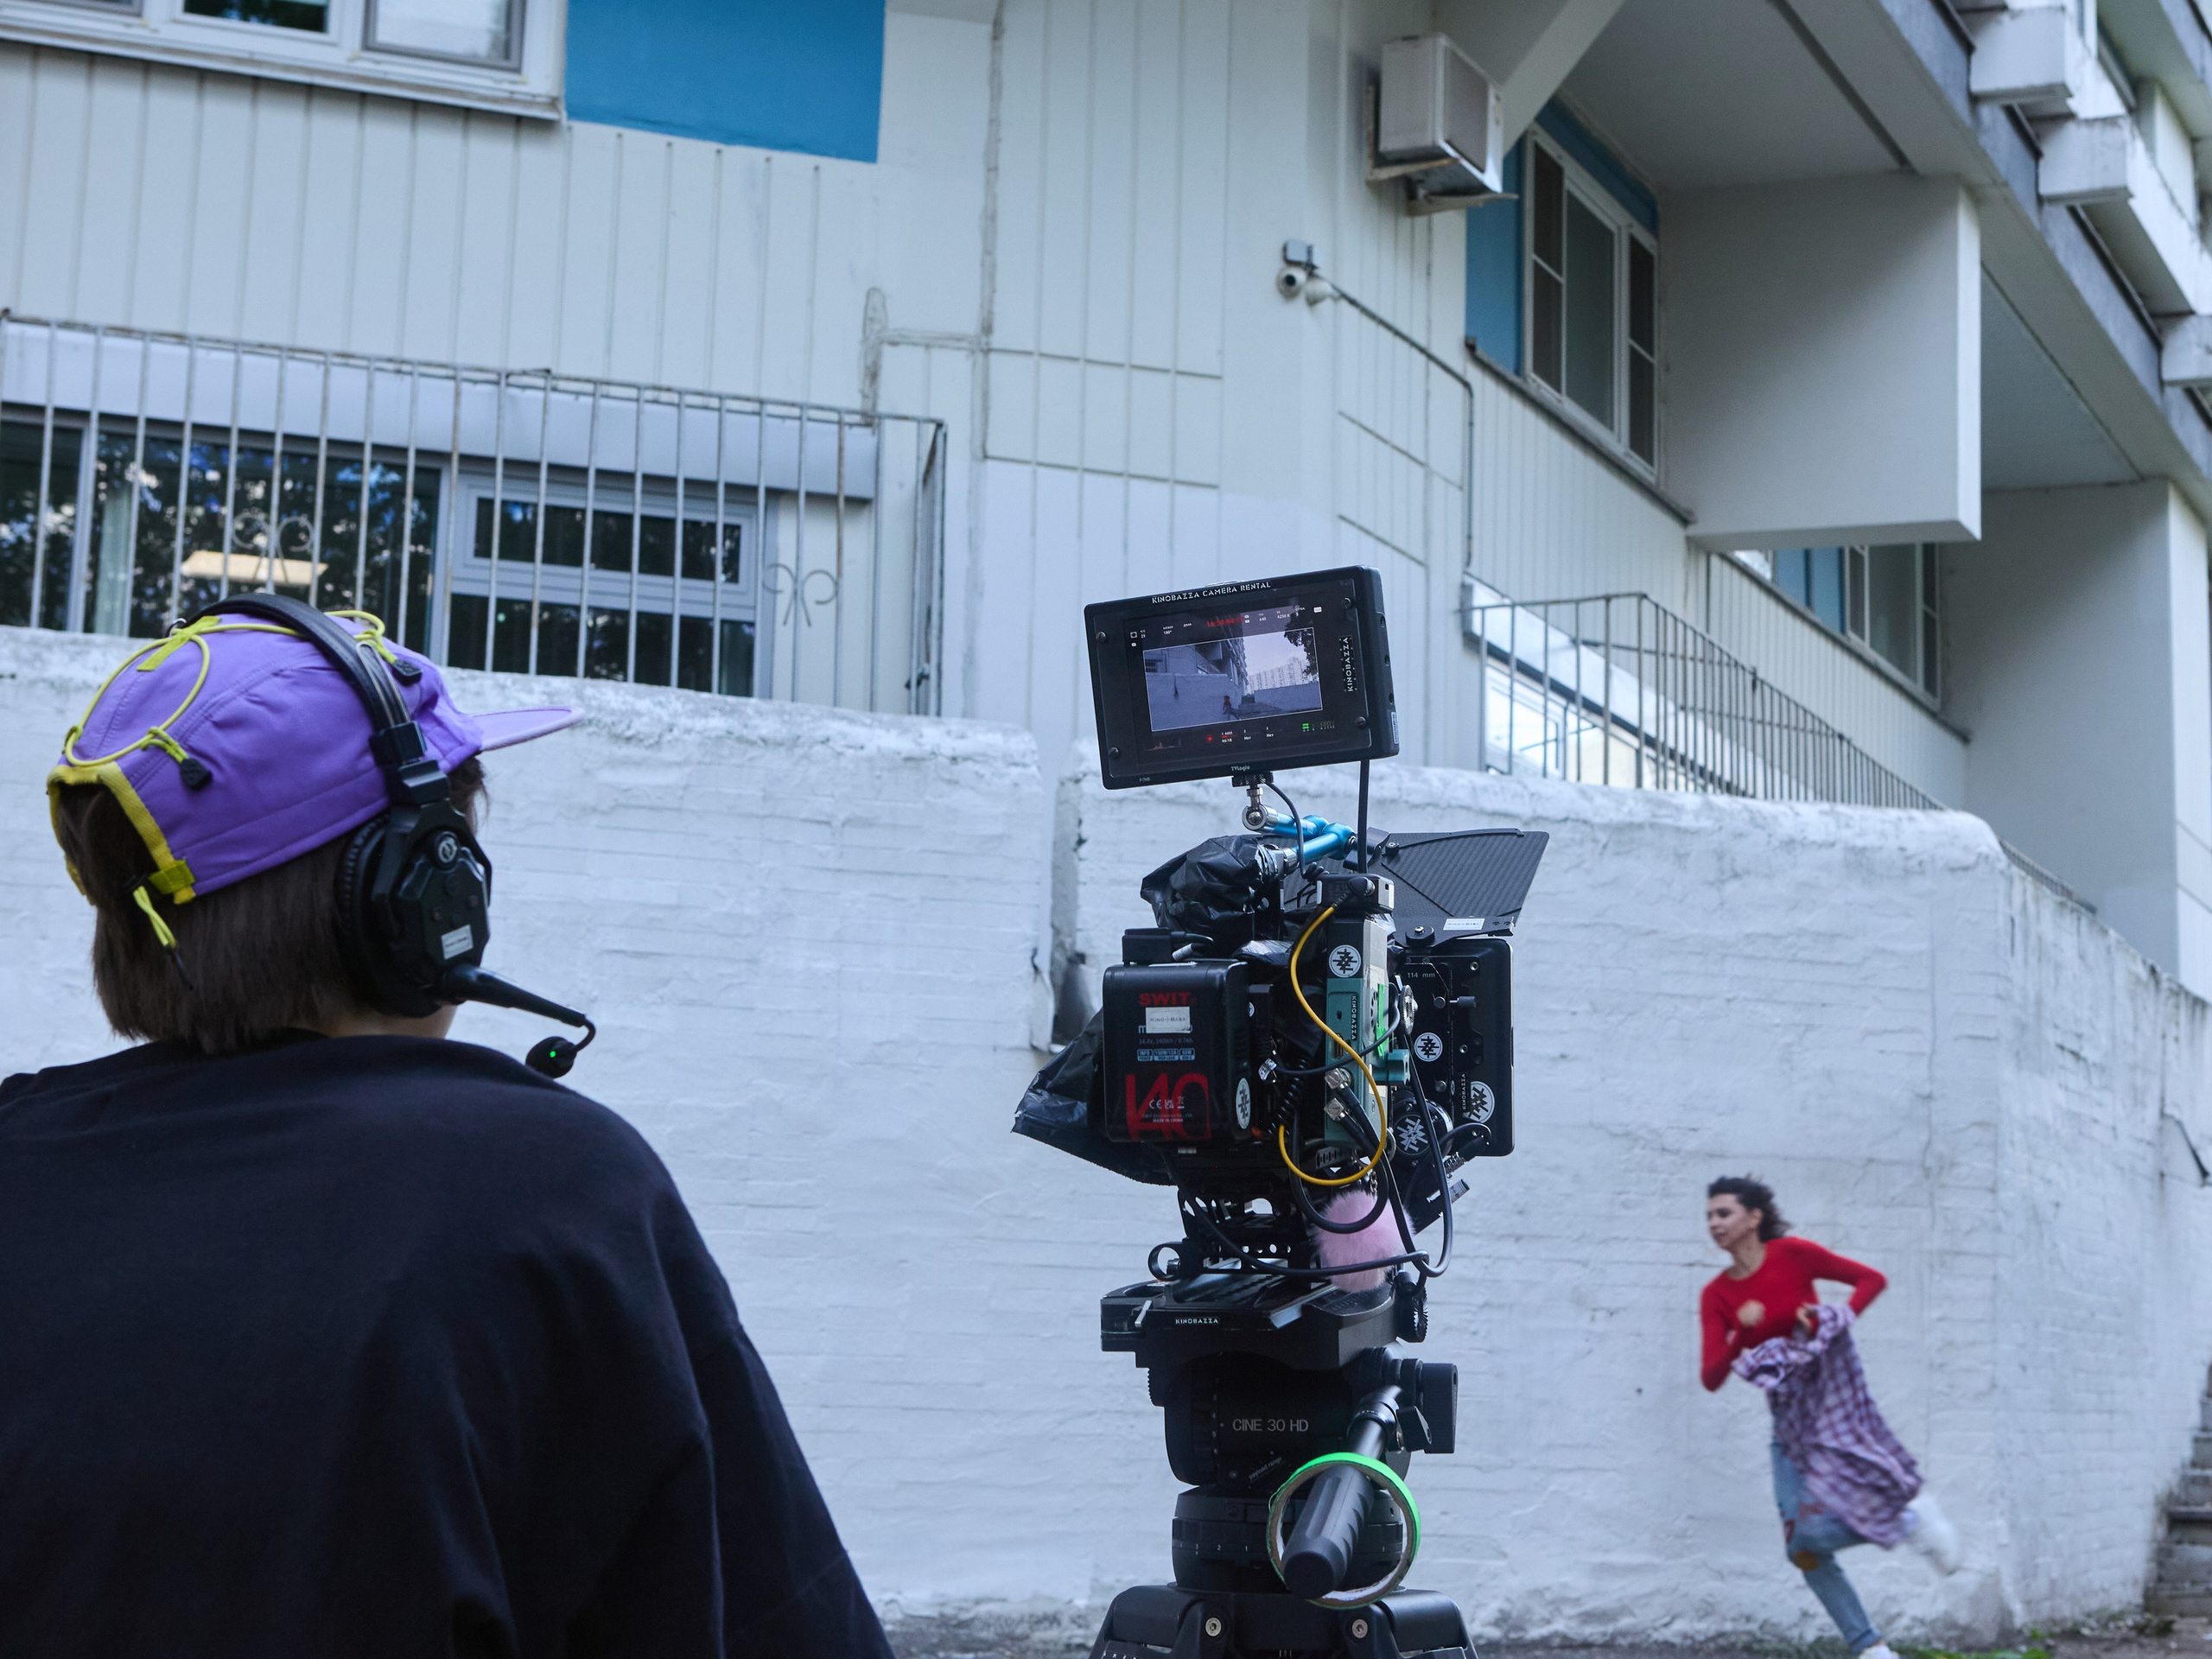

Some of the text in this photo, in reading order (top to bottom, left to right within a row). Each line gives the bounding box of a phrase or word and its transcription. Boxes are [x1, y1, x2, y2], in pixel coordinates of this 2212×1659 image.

[1152, 582, 1271, 604] KINOBAZZA CAMERA RENTAL
[1342, 637, 1354, 692] KINOBAZZA
[1139, 992, 1191, 1007] SWIT
[1232, 1419, 1309, 1432] CINE 30 HD
